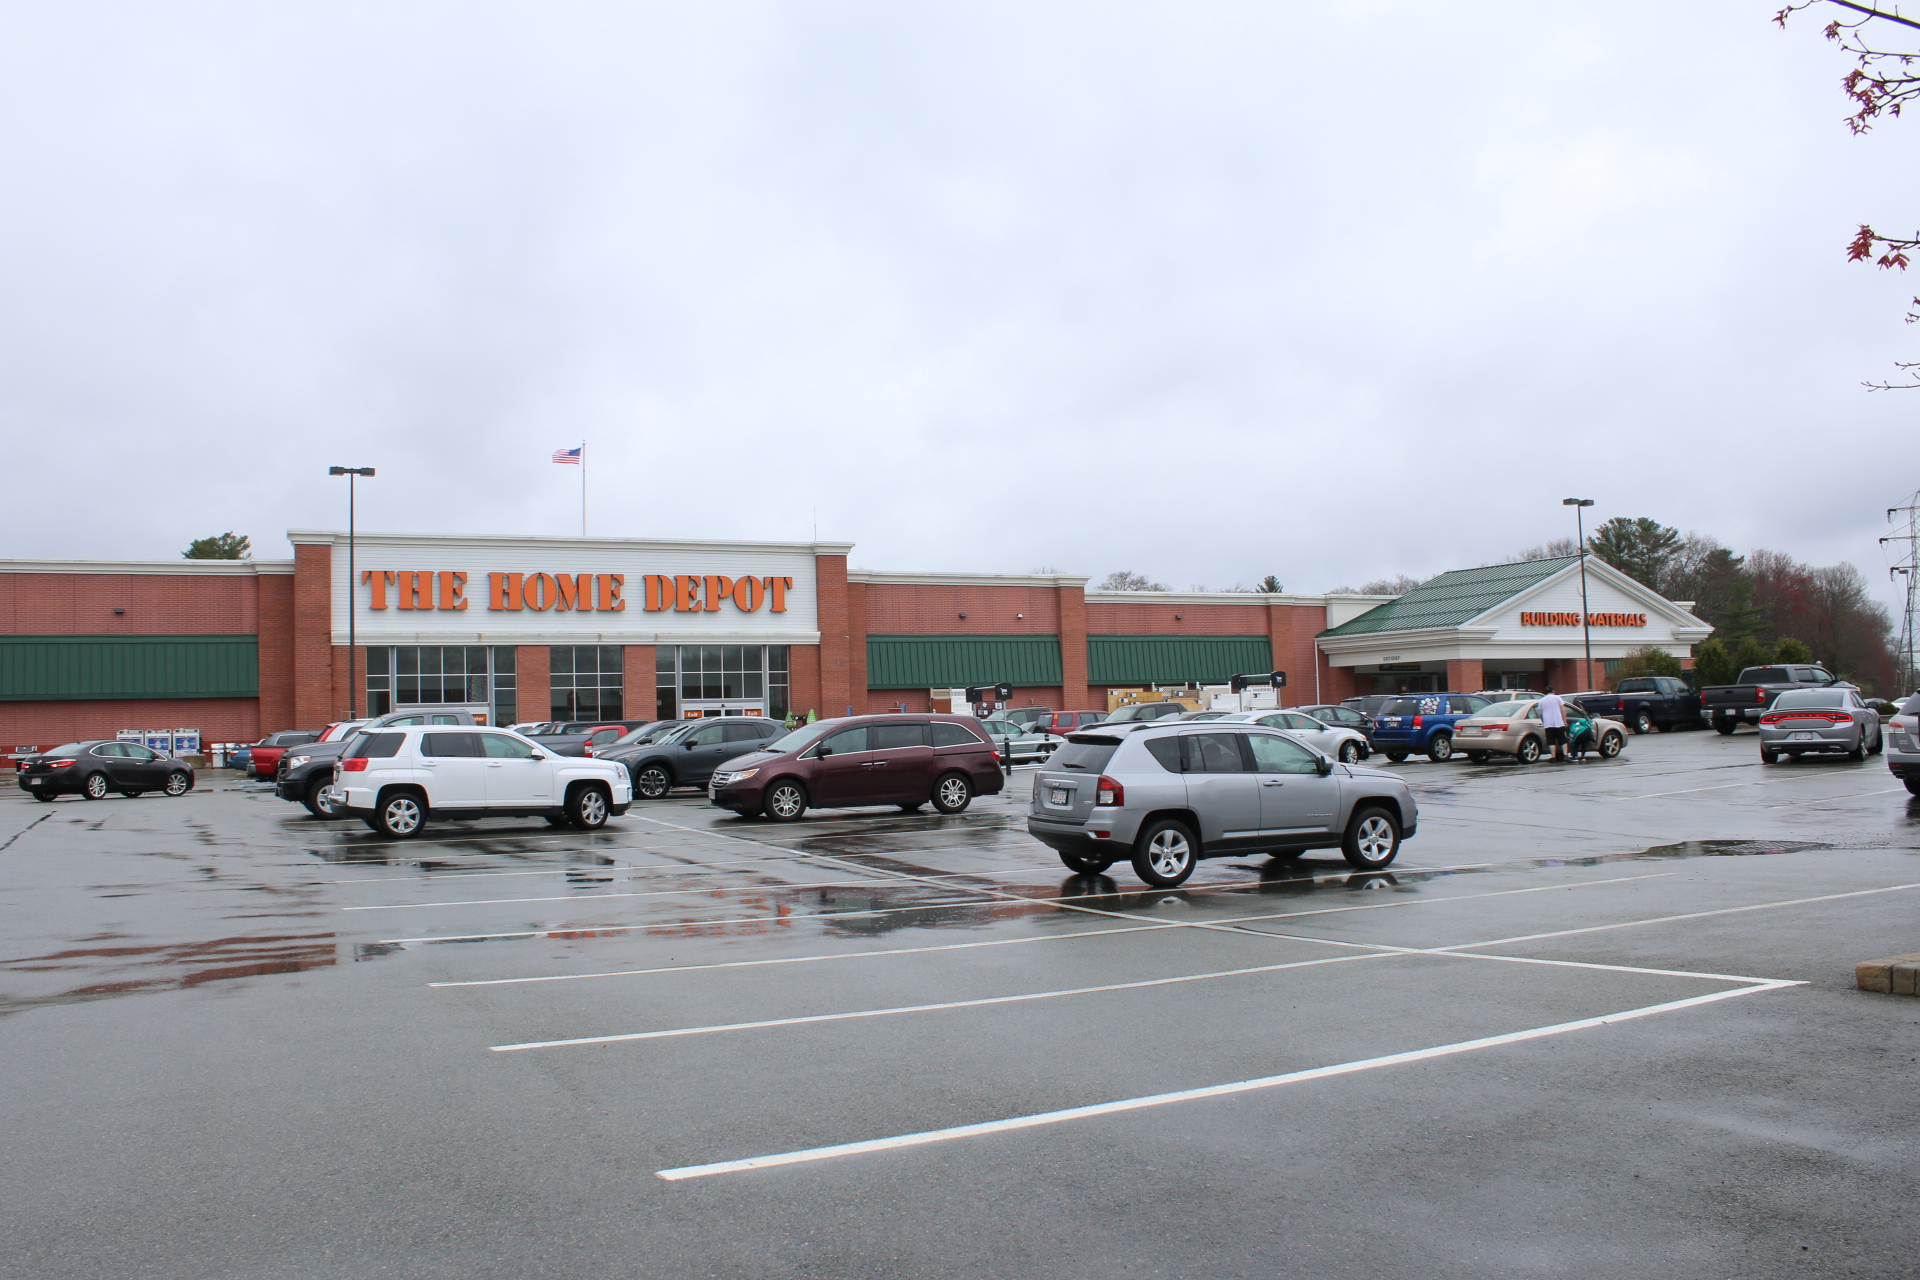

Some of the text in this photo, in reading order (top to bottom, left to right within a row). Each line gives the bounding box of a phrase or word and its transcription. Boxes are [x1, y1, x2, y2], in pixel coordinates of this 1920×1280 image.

[361, 570, 793, 613] THE HOME DEPOT
[1521, 611, 1647, 627] BUILDING MATERIALS
